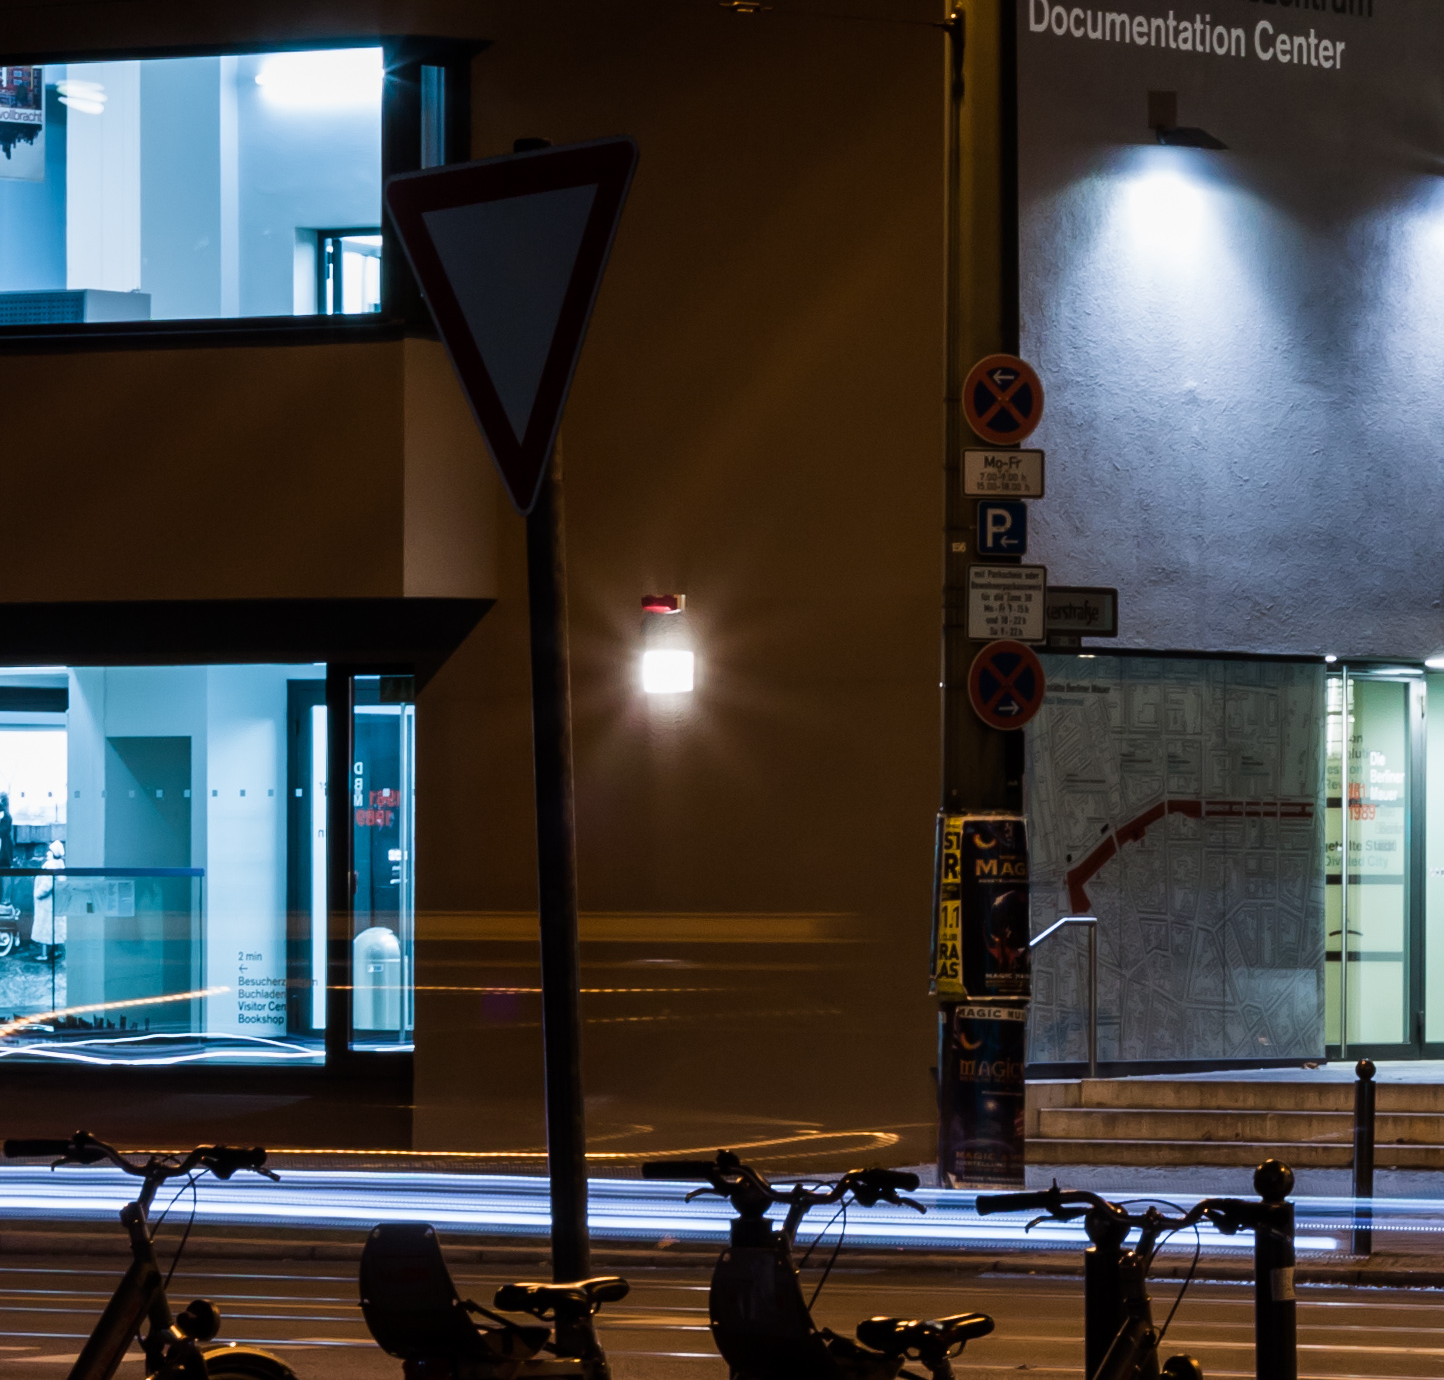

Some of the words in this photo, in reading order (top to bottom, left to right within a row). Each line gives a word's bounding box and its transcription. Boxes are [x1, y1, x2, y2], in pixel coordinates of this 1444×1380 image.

[1254, 20, 1346, 69] Center
[984, 455, 1022, 469] Mo-Fr
[987, 508, 1012, 548] P
[975, 858, 1027, 877] MAG
[238, 952, 244, 961] 2
[245, 951, 262, 961] min
[238, 989, 287, 999] Buchladen
[238, 1001, 266, 1011] Visitor
[268, 1001, 287, 1011] Cen
[238, 1014, 285, 1025] Bookshop
